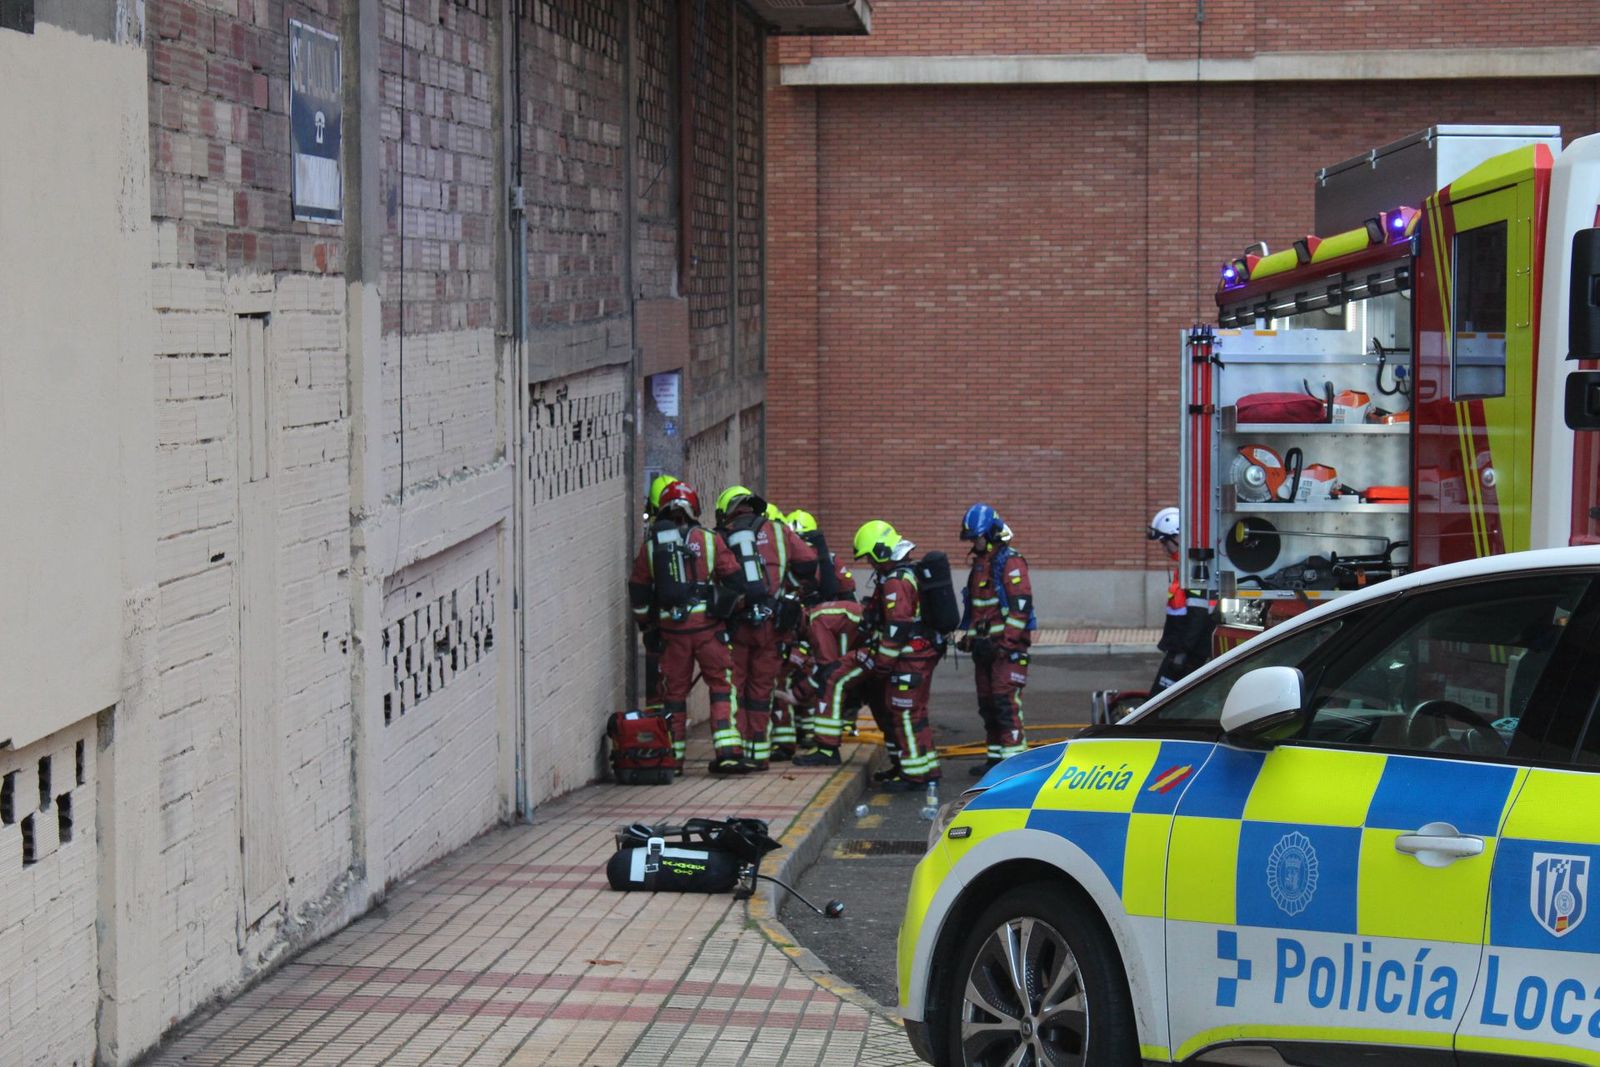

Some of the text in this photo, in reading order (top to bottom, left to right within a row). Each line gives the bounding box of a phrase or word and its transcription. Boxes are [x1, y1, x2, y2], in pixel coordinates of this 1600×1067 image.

[1054, 764, 1134, 790] Policía
[1536, 858, 1586, 932] 175
[1274, 937, 1458, 1020] Policía
